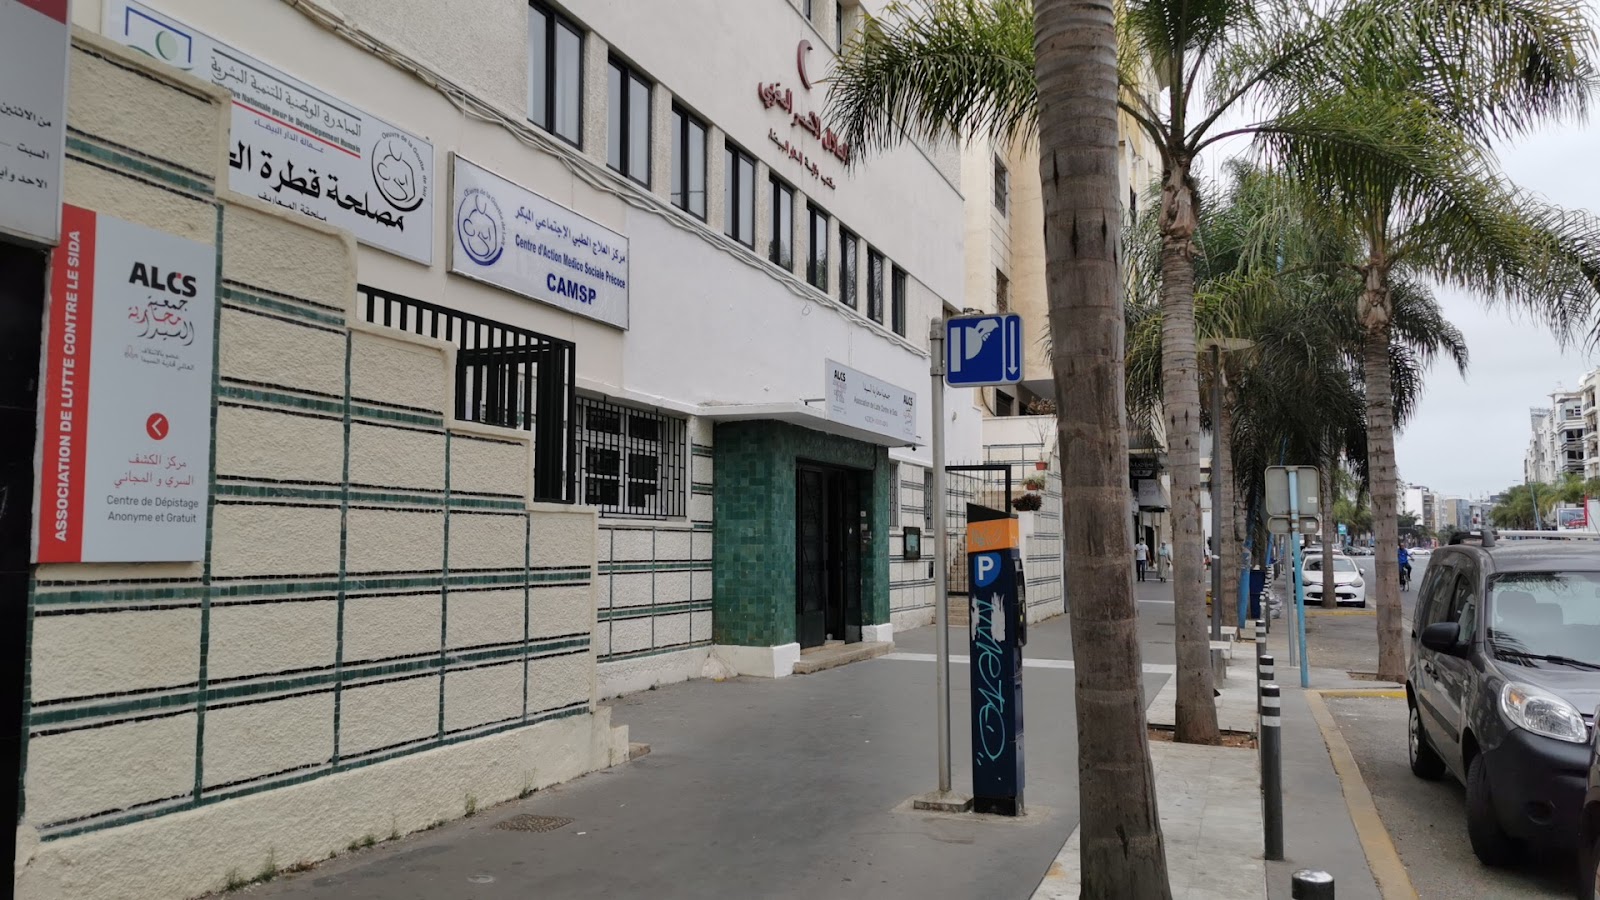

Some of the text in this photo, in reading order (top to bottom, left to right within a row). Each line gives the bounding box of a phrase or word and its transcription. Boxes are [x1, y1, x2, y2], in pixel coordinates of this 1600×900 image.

[211, 56, 248, 84] البشرية
[250, 74, 283, 101] للتنمية
[286, 91, 320, 119] الوطنية
[37, 116, 52, 128] من
[242, 93, 271, 112] Nationale
[272, 107, 288, 121] pour
[288, 114, 294, 123] le
[296, 117, 339, 144] Développement
[324, 109, 361, 137] المبادرة
[284, 129, 298, 143] الدار
[17, 142, 50, 160] السبت
[260, 149, 321, 199] قطرة
[258, 191, 327, 222] ملحقة المعاريف
[326, 173, 405, 232] مصلحة
[515, 206, 534, 224] المبكر
[572, 232, 592, 248] الطبي
[592, 239, 611, 256] العلاج
[515, 233, 537, 254] Centre
[538, 243, 562, 263] d'Action
[584, 262, 605, 281] Sociale
[611, 247, 626, 264] مركز
[129, 261, 197, 298] ALCS
[546, 272, 597, 305] CAMSP
[128, 303, 182, 326] محاربة
[147, 295, 188, 312] جمعية
[136, 307, 195, 347] السيدا
[55, 231, 80, 542] ASSOCIATION DE LUTTE CONTRE LE SIDA
[834, 369, 846, 382] ALCS
[903, 394, 913, 407] ALCS
[128, 452, 187, 471] مركز الكشف
[114, 470, 194, 489] السري و المجاني
[106, 494, 199, 510] Centre de Dépistage
[107, 511, 197, 523] Anonyme et Gratuit
[977, 555, 995, 581] P
